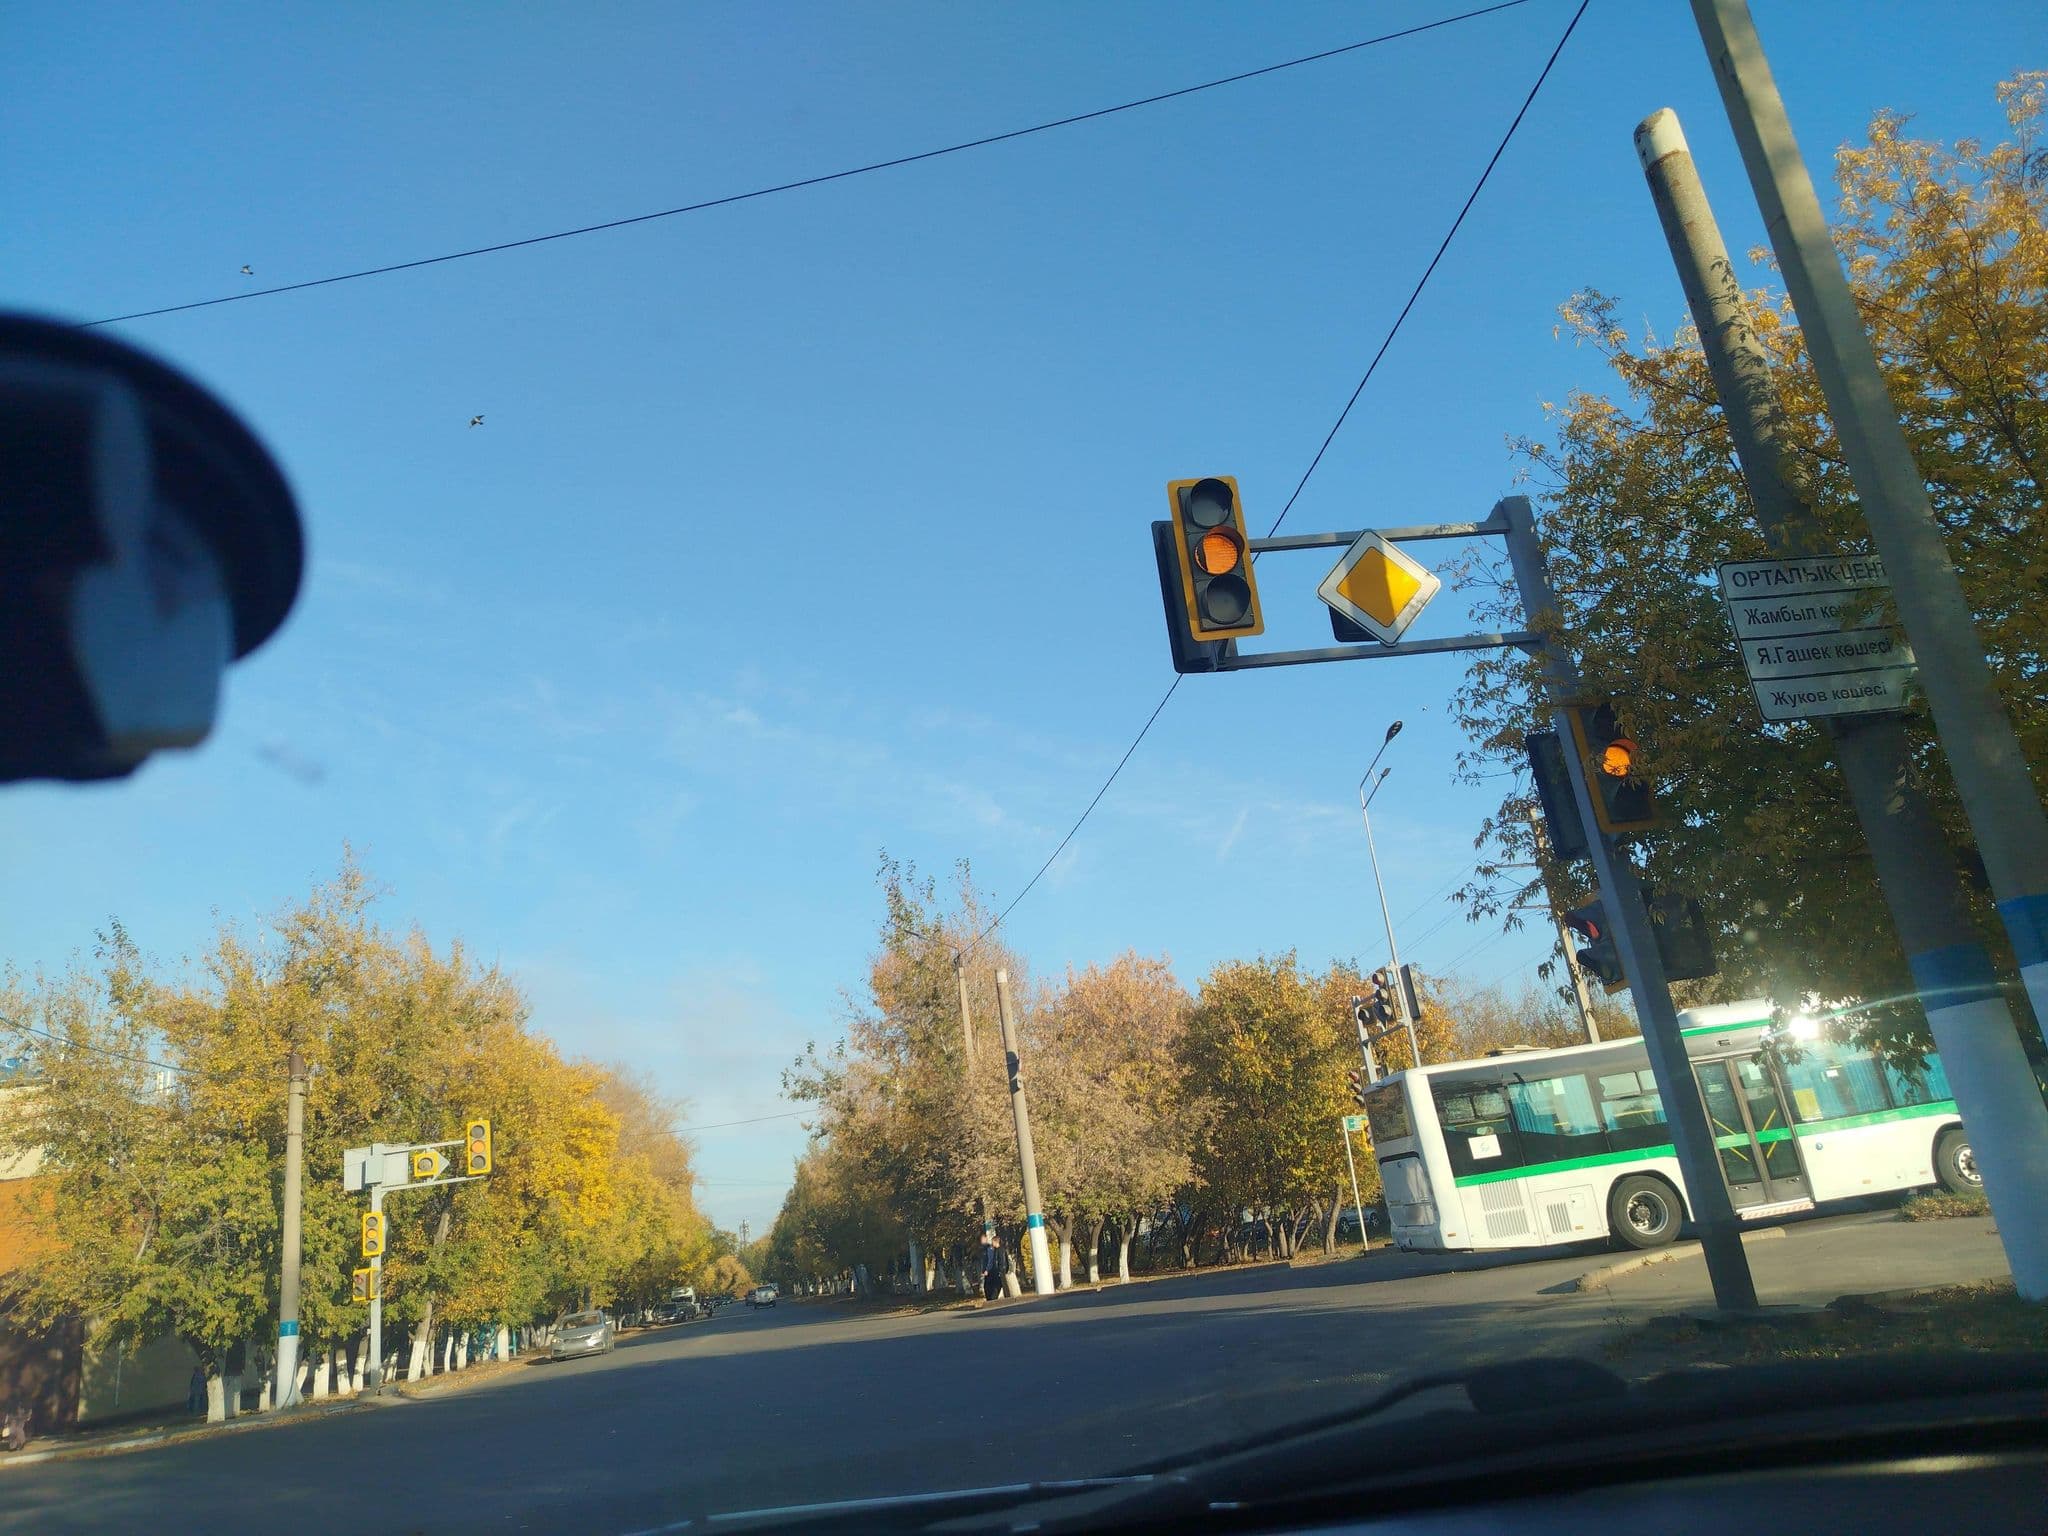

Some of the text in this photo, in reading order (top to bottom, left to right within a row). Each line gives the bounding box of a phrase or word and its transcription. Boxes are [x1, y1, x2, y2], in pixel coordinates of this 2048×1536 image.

[1744, 605, 1817, 625] Жамбыл
[1757, 637, 1892, 664] Я.Гашек көшесі
[1770, 681, 1887, 708] Жуков көшесі
